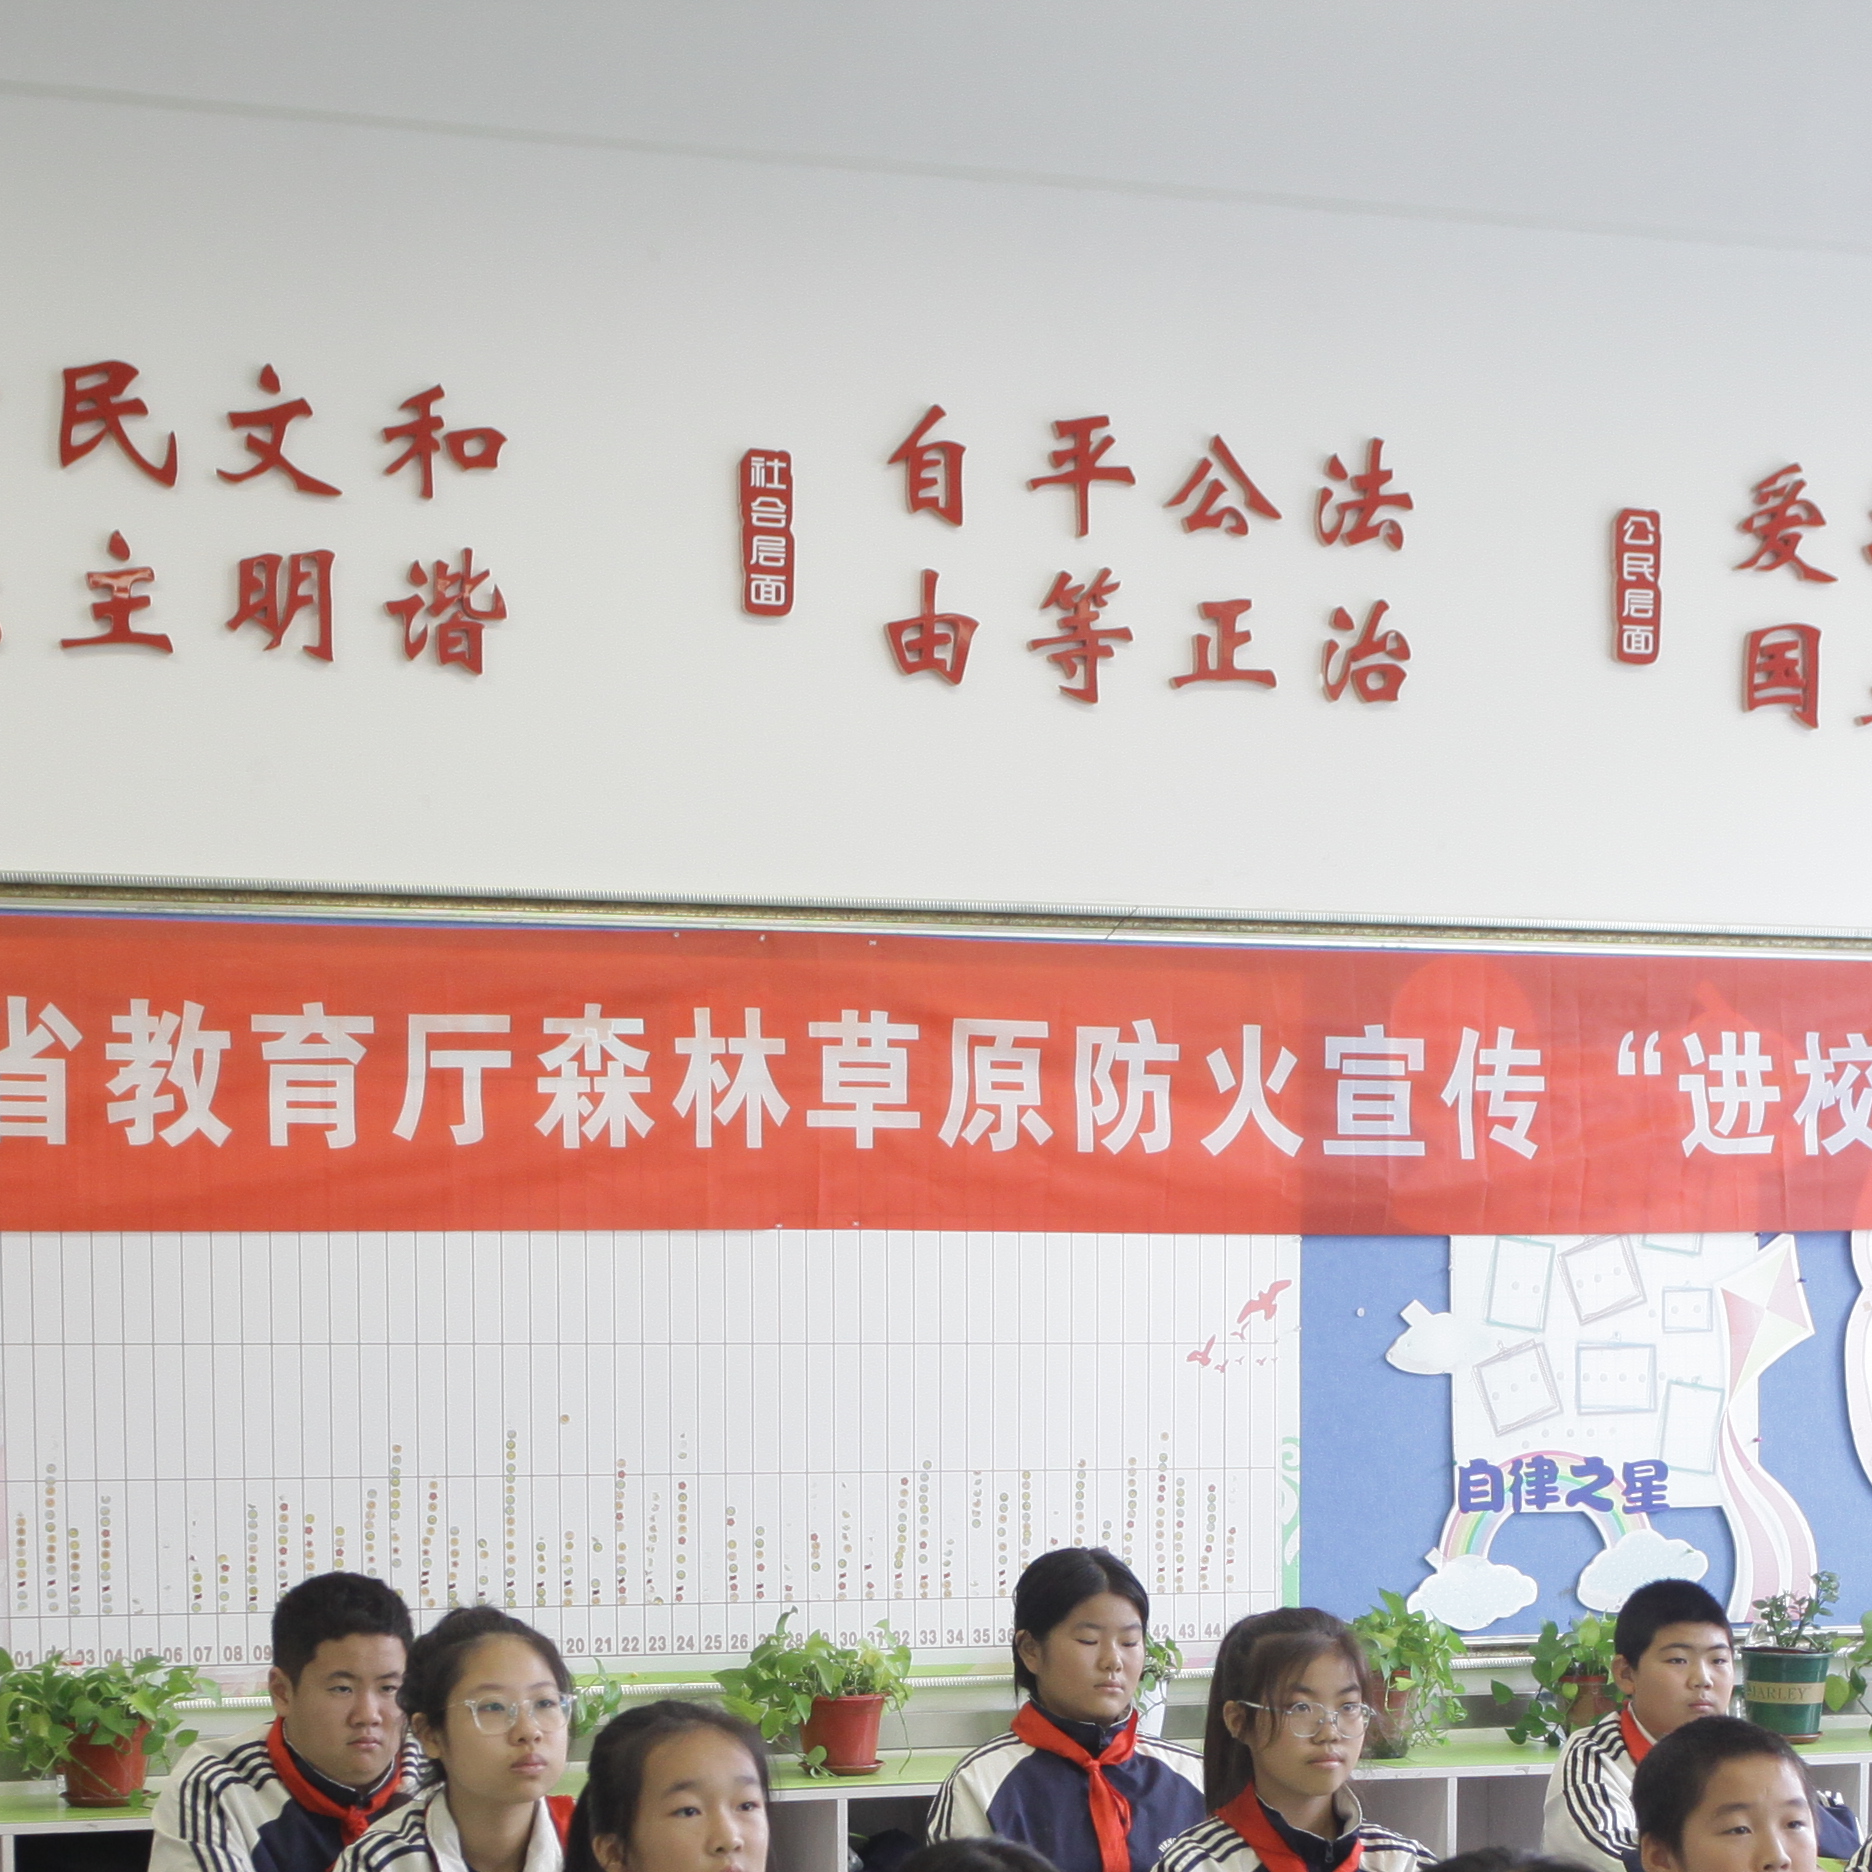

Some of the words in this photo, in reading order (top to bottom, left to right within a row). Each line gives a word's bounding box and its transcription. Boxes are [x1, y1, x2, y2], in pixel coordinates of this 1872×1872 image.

[748, 456, 788, 607] 社会层面
[1622, 514, 1656, 656] 公民层面
[1458, 1457, 1670, 1514] 自律之星
[15, 1651, 33, 1667] 01
[164, 1647, 183, 1663] 06
[193, 1646, 213, 1662] 07
[223, 1645, 242, 1661] 08
[254, 1645, 273, 1661] 09
[566, 1637, 585, 1653] 20
[595, 1637, 612, 1652] 21
[622, 1636, 639, 1652] 22
[648, 1636, 666, 1651] 23
[677, 1635, 695, 1650] 24
[704, 1635, 722, 1650] 25
[731, 1634, 748, 1649] 26
[840, 1631, 857, 1646] 30
[920, 1629, 936, 1645] 33
[947, 1629, 964, 1644] 34
[973, 1628, 990, 1643] 35
[1153, 1624, 1169, 1639] 42
[1179, 1623, 1195, 1638] 43
[1204, 1623, 1221, 1638] 44
